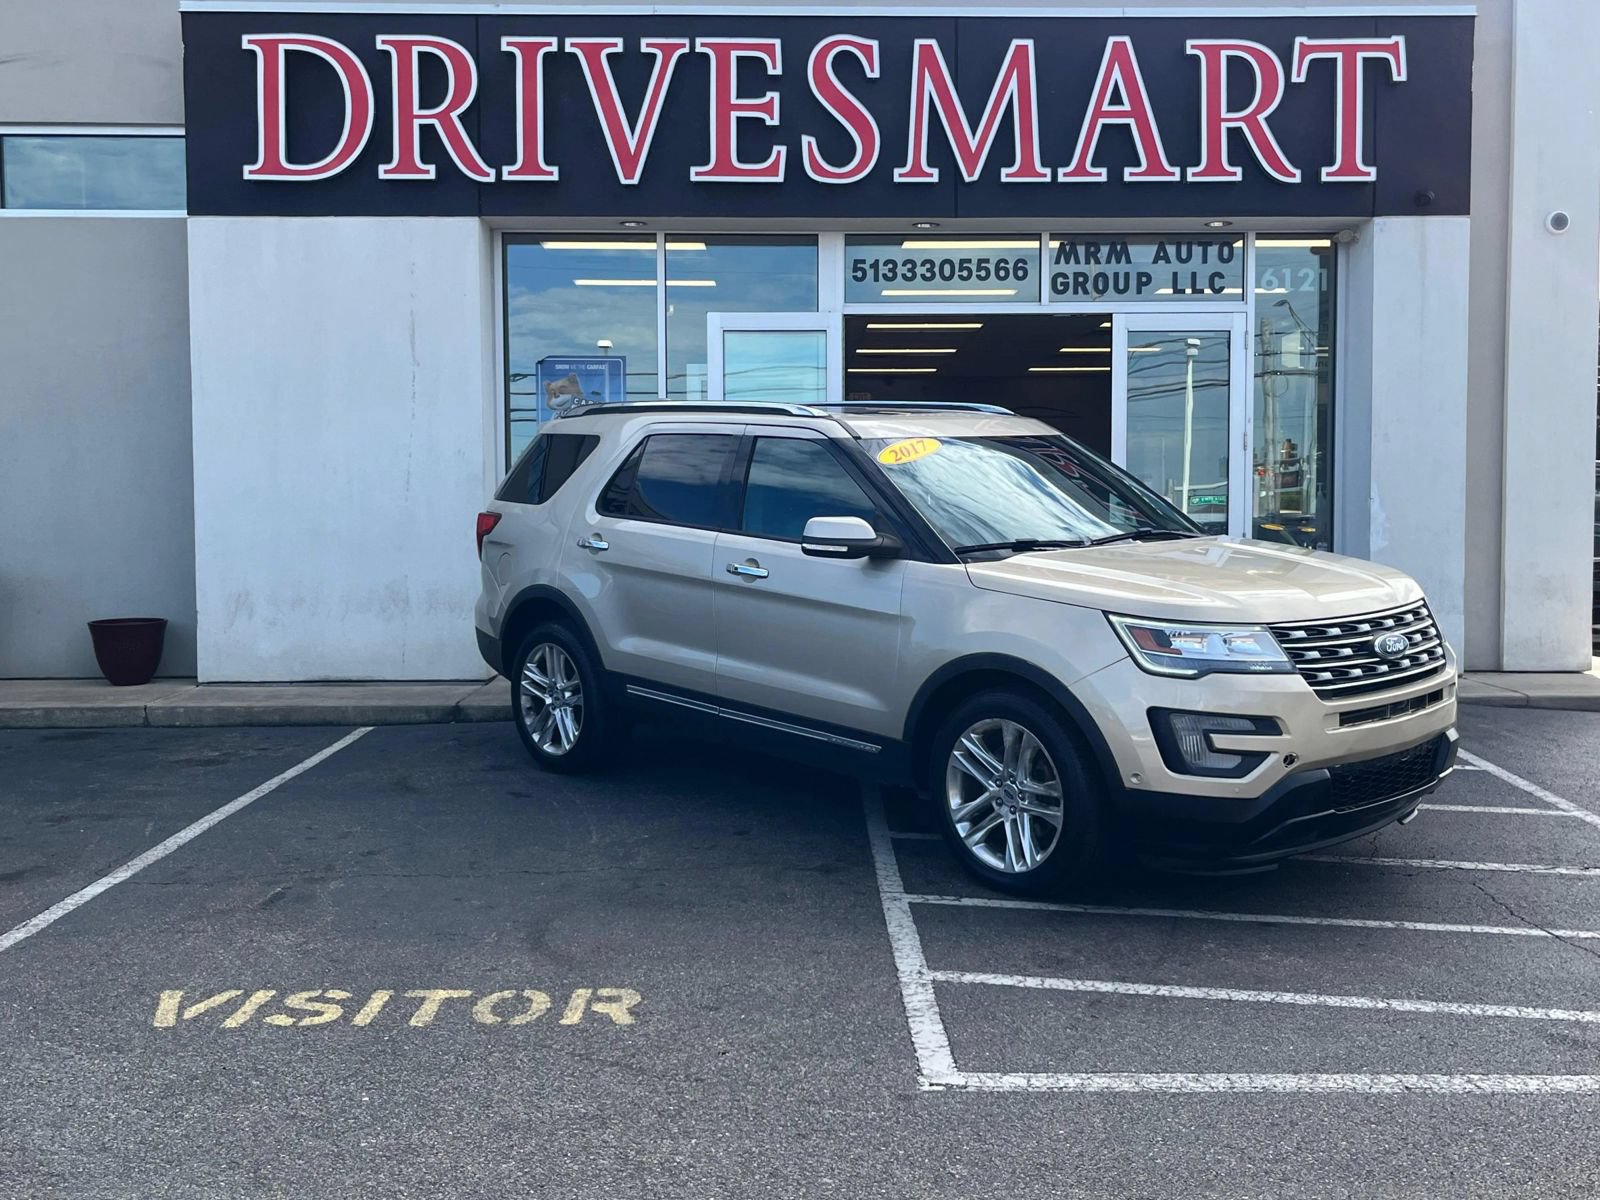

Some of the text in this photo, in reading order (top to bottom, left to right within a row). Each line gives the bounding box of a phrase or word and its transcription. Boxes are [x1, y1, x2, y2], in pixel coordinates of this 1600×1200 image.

[240, 33, 1408, 185] DRIVESMART
[1054, 241, 1235, 265] MRM AUTO
[851, 258, 1029, 283] 5133305566
[1260, 268, 1328, 292] 6121
[1050, 271, 1226, 296] GROUP LLC
[889, 440, 927, 463] 2017
[1385, 637, 1405, 652] Ford
[152, 988, 643, 1029] VISITOR
